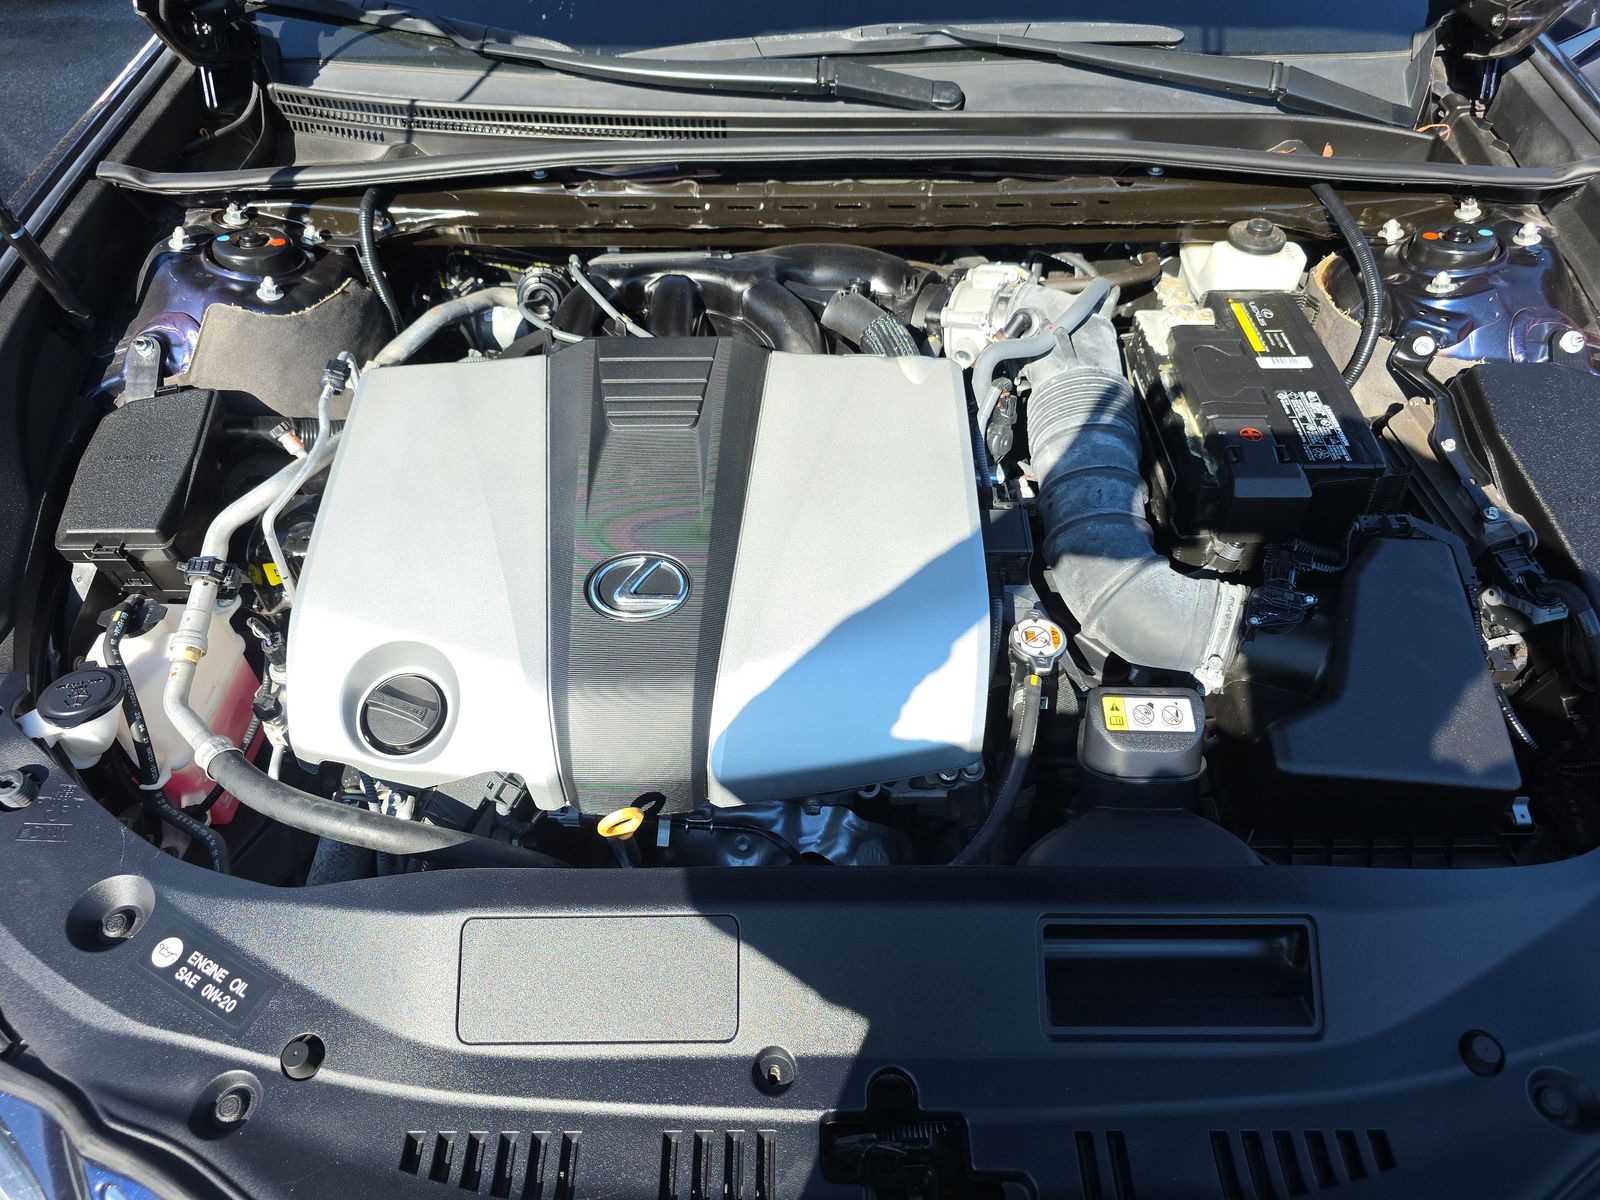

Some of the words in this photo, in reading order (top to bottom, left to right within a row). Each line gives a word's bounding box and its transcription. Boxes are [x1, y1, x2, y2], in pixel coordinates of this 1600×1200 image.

[1248, 301, 1267, 326] LEXUS
[174, 966, 201, 989] SAE
[201, 983, 237, 1013] 0W-20
[187, 951, 229, 983] ENGINE
[229, 978, 248, 998] OIL
